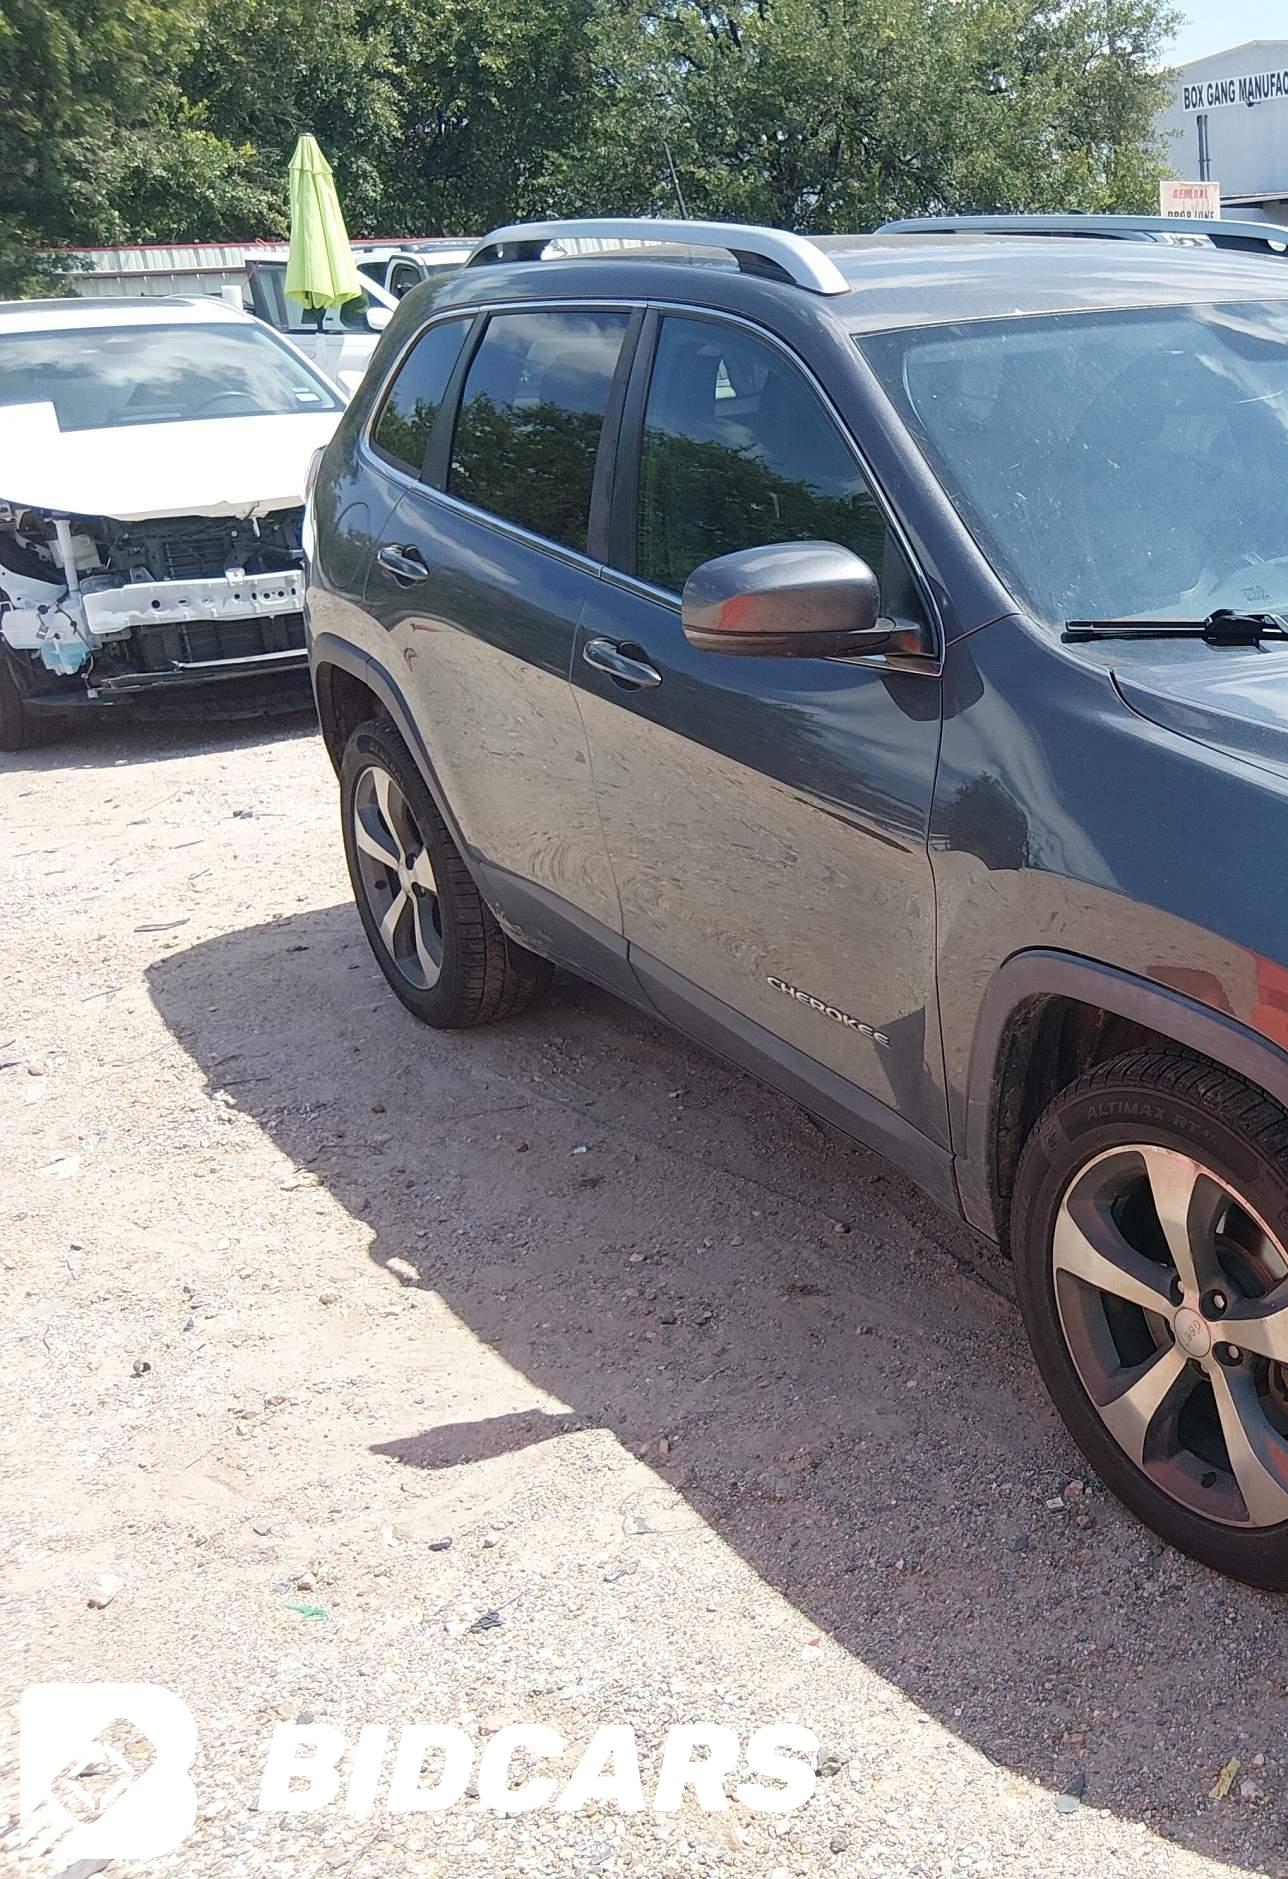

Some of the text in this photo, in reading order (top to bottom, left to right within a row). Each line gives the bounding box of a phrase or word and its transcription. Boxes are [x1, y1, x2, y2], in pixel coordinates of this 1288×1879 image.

[1183, 84, 1204, 109] BOX
[1206, 79, 1235, 106] GANG
[766, 975, 893, 1047] CHEROKEE
[1087, 1102, 1166, 1121] ALTIMAX
